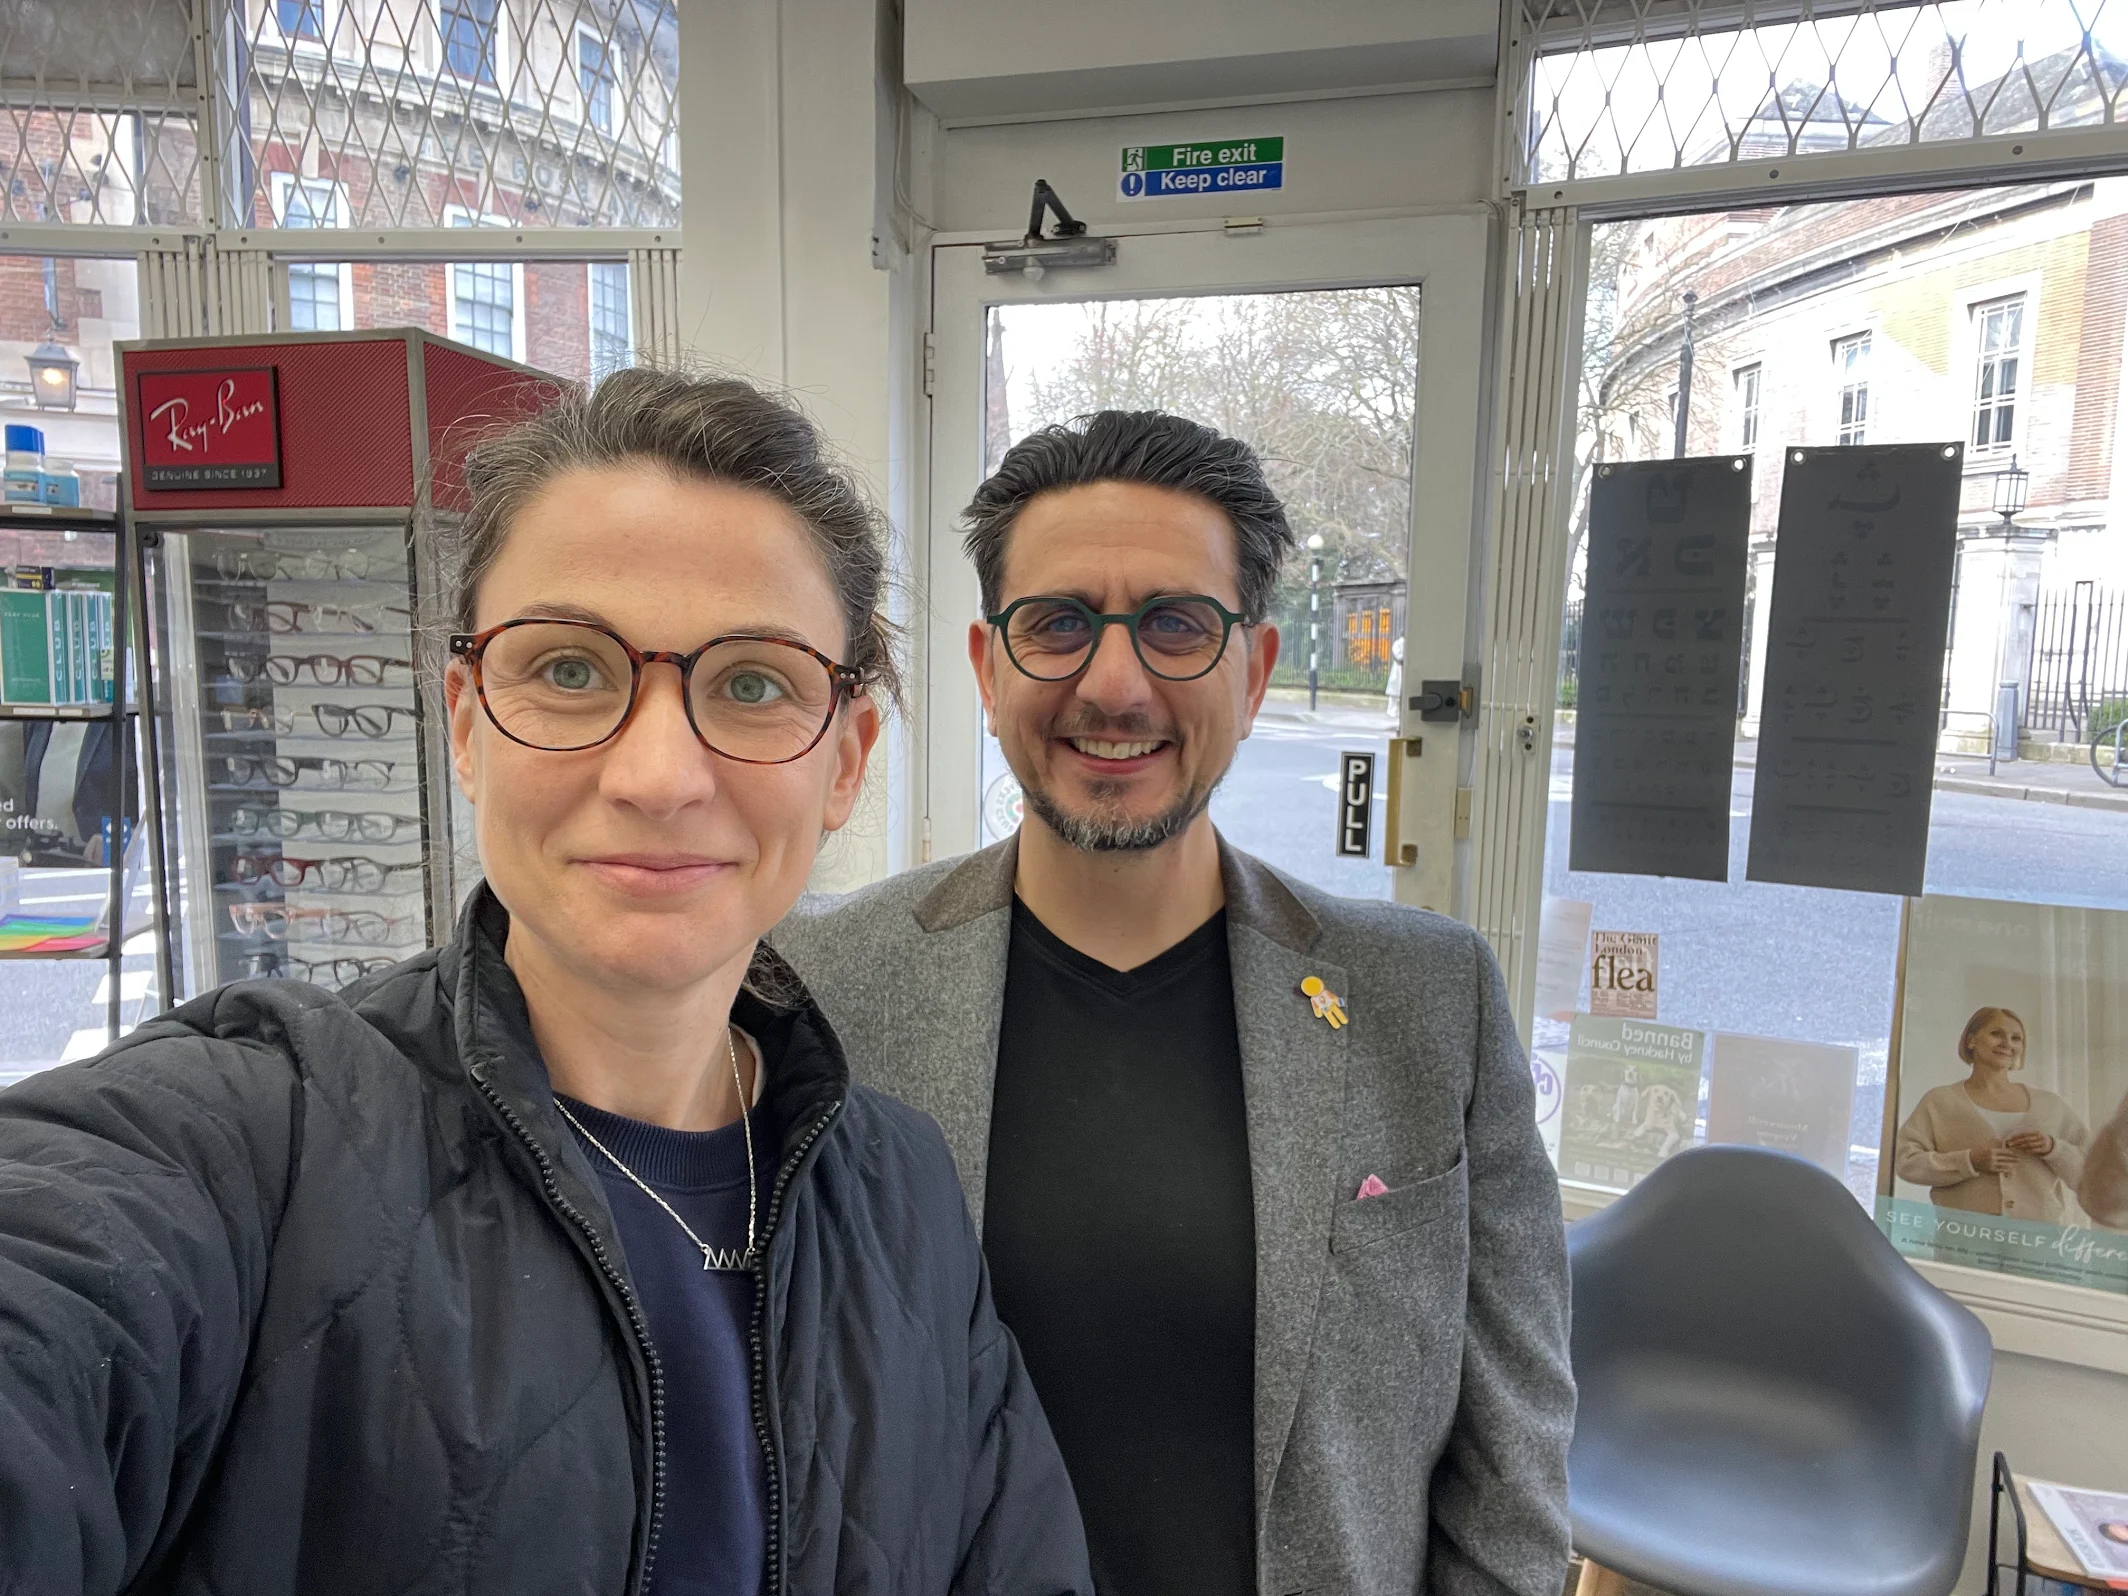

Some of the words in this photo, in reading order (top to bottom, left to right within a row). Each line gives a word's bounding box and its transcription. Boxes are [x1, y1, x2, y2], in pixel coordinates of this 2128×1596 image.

[1173, 147, 1212, 166] Fire
[1218, 143, 1257, 163] exit
[1161, 172, 1211, 192] Keep
[1217, 168, 1267, 186] clear
[149, 379, 264, 453] Ray-Ban
[152, 470, 199, 481] GENUINE
[204, 468, 237, 480] SINCE
[241, 467, 267, 479] 1937
[1345, 759, 1368, 851] PULL
[6, 814, 58, 830] offers.
[1595, 943, 1643, 955] London
[1592, 955, 1655, 992] flea
[1886, 1211, 1924, 1228] SEE
[1934, 1219, 2046, 1248] YOURSELF
